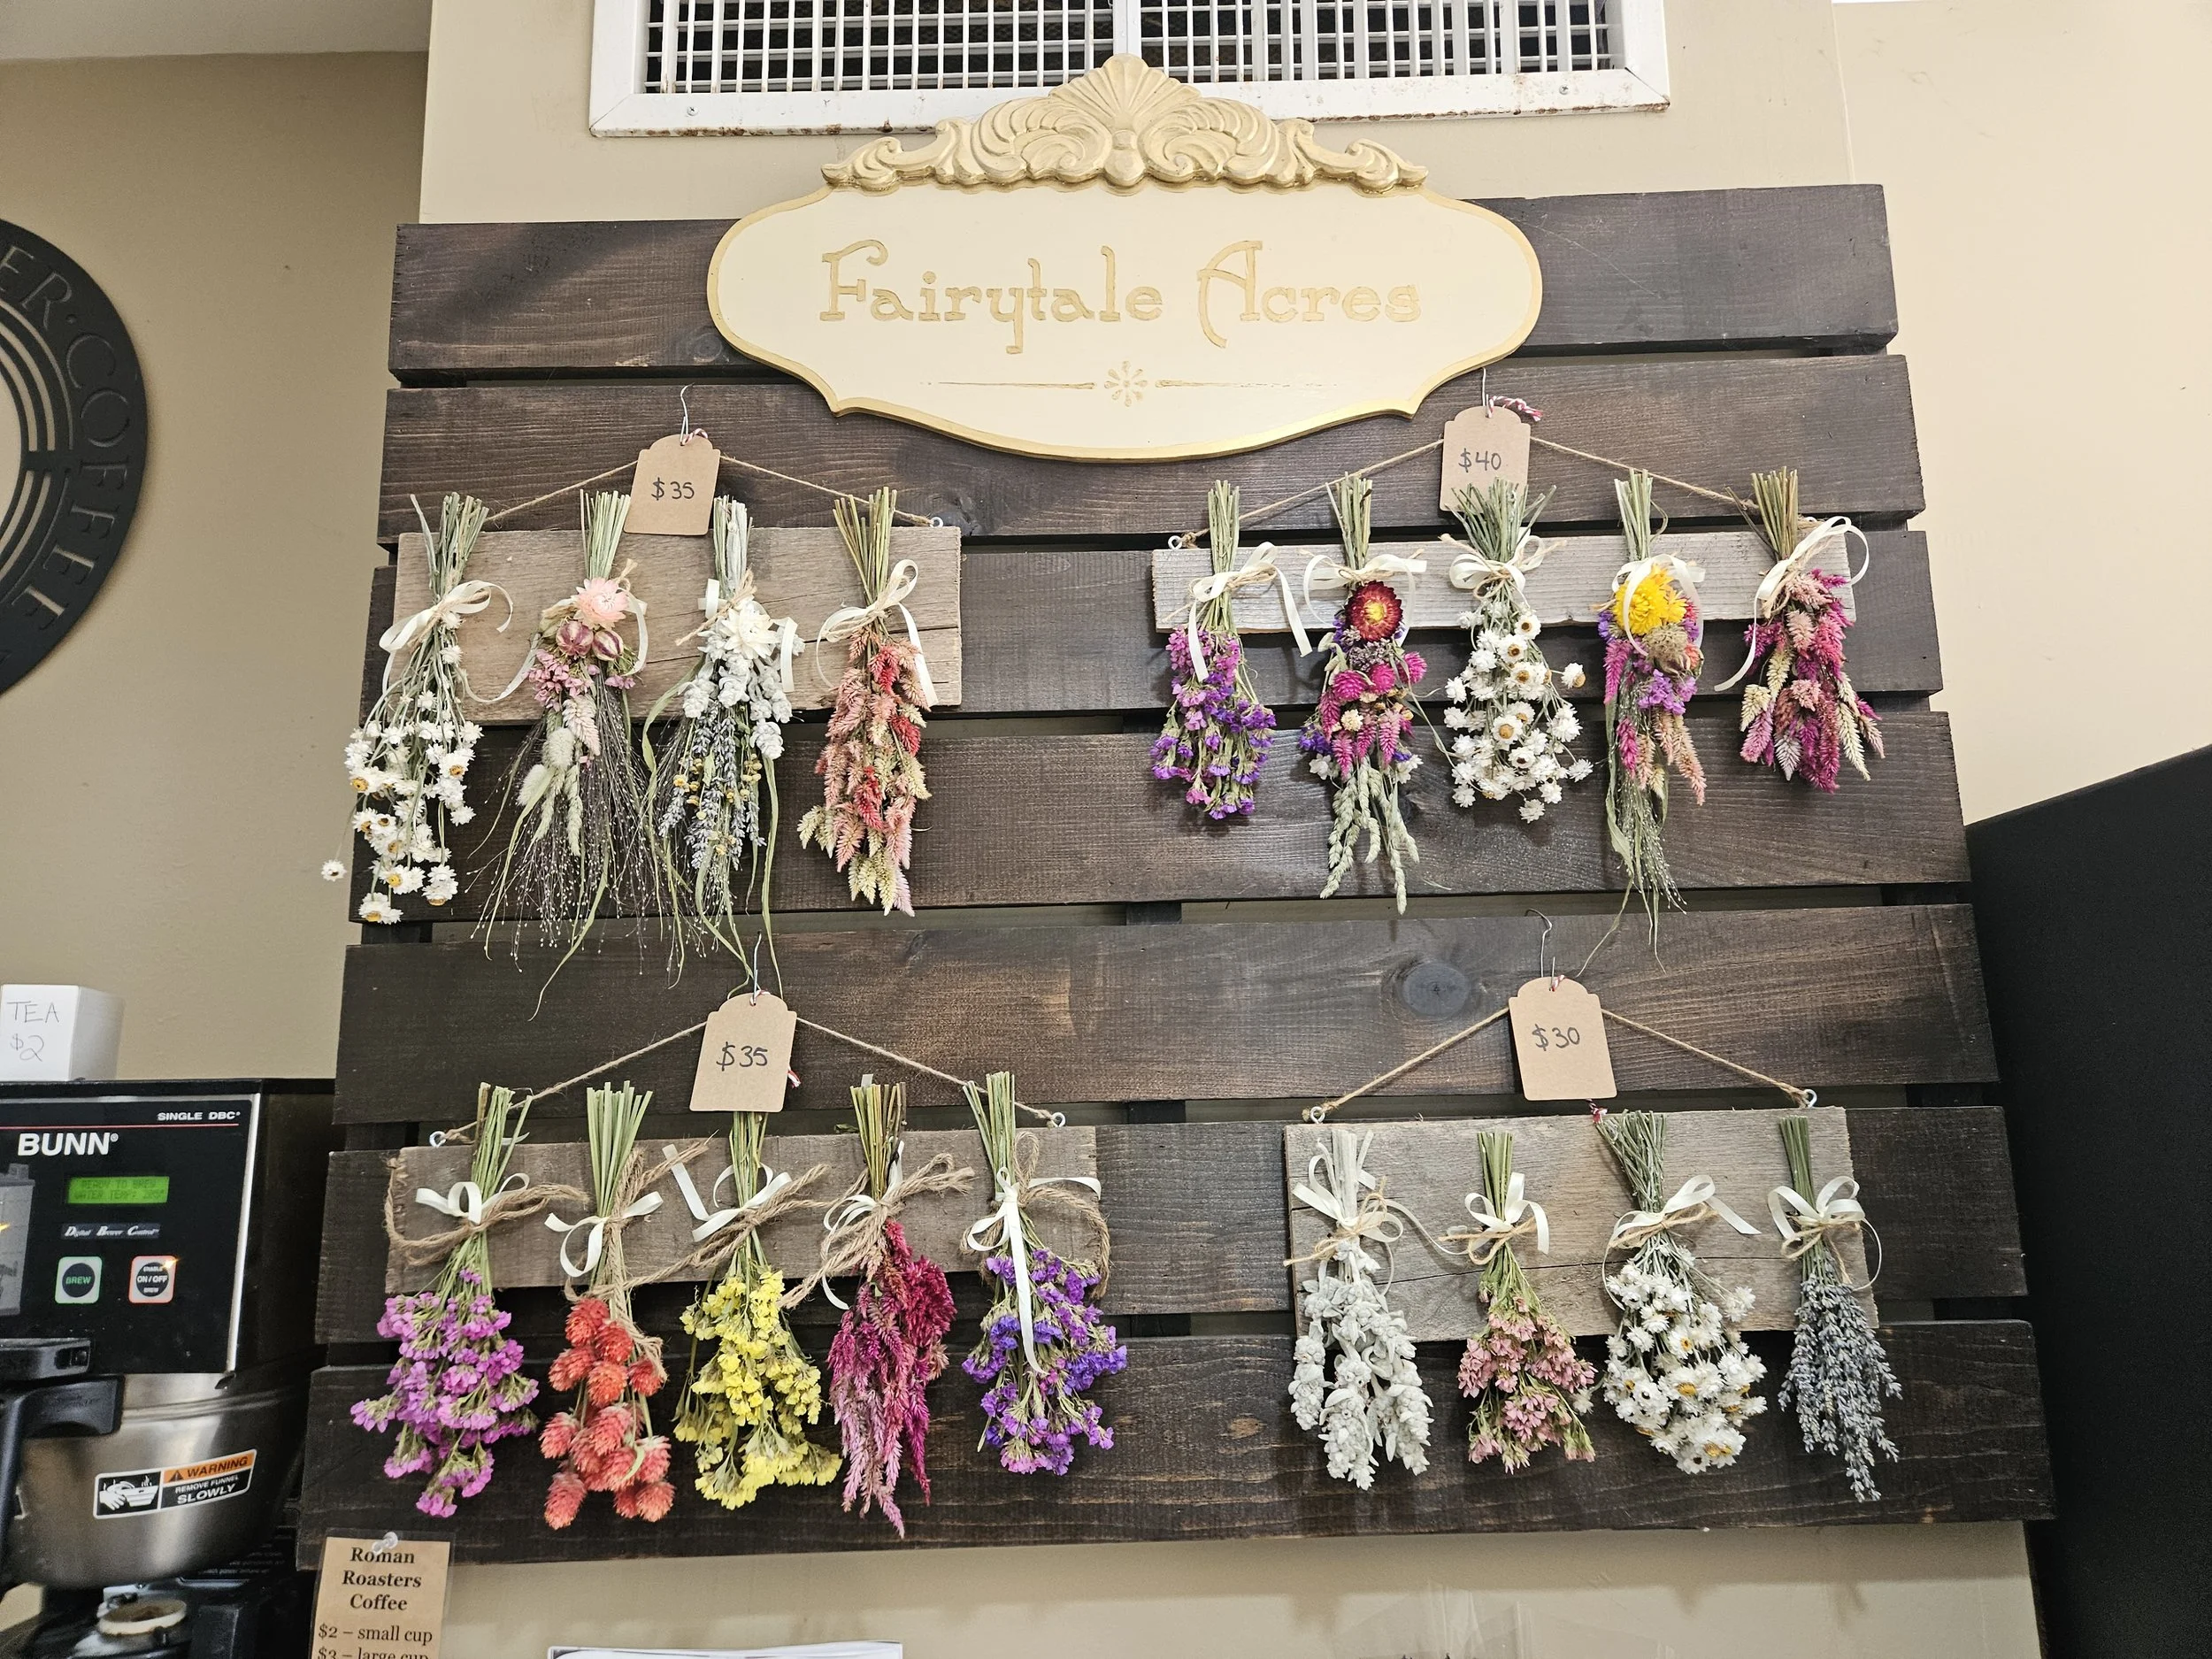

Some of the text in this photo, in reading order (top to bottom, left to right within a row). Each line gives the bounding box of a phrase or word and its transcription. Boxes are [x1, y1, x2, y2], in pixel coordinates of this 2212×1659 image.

[819, 239, 1421, 355] Fairytale Acres
[1458, 448, 1502, 473] $40
[11, 334, 130, 631] COFFEE
[651, 477, 695, 501] $35
[7, 1001, 59, 1023] TEA
[10, 1033, 44, 1062] $2
[1532, 1023, 1580, 1051] $30
[716, 1041, 768, 1071] $35
[157, 1112, 203, 1121] SINGLE
[65, 1276, 91, 1285] BREW
[187, 1455, 248, 1478] WARNING
[175, 1475, 239, 1494] REMOVE FUNNEL
[177, 1484, 236, 1505] SLOWLY
[349, 1547, 415, 1563] Roman
[342, 1570, 422, 1587] Roasters
[350, 1594, 408, 1610] Coffee
[319, 1623, 338, 1640] $2
[357, 1625, 400, 1641] small
[404, 1630, 433, 1646] cup
[317, 1646, 337, 1659] $3
[357, 1647, 396, 1659] large
